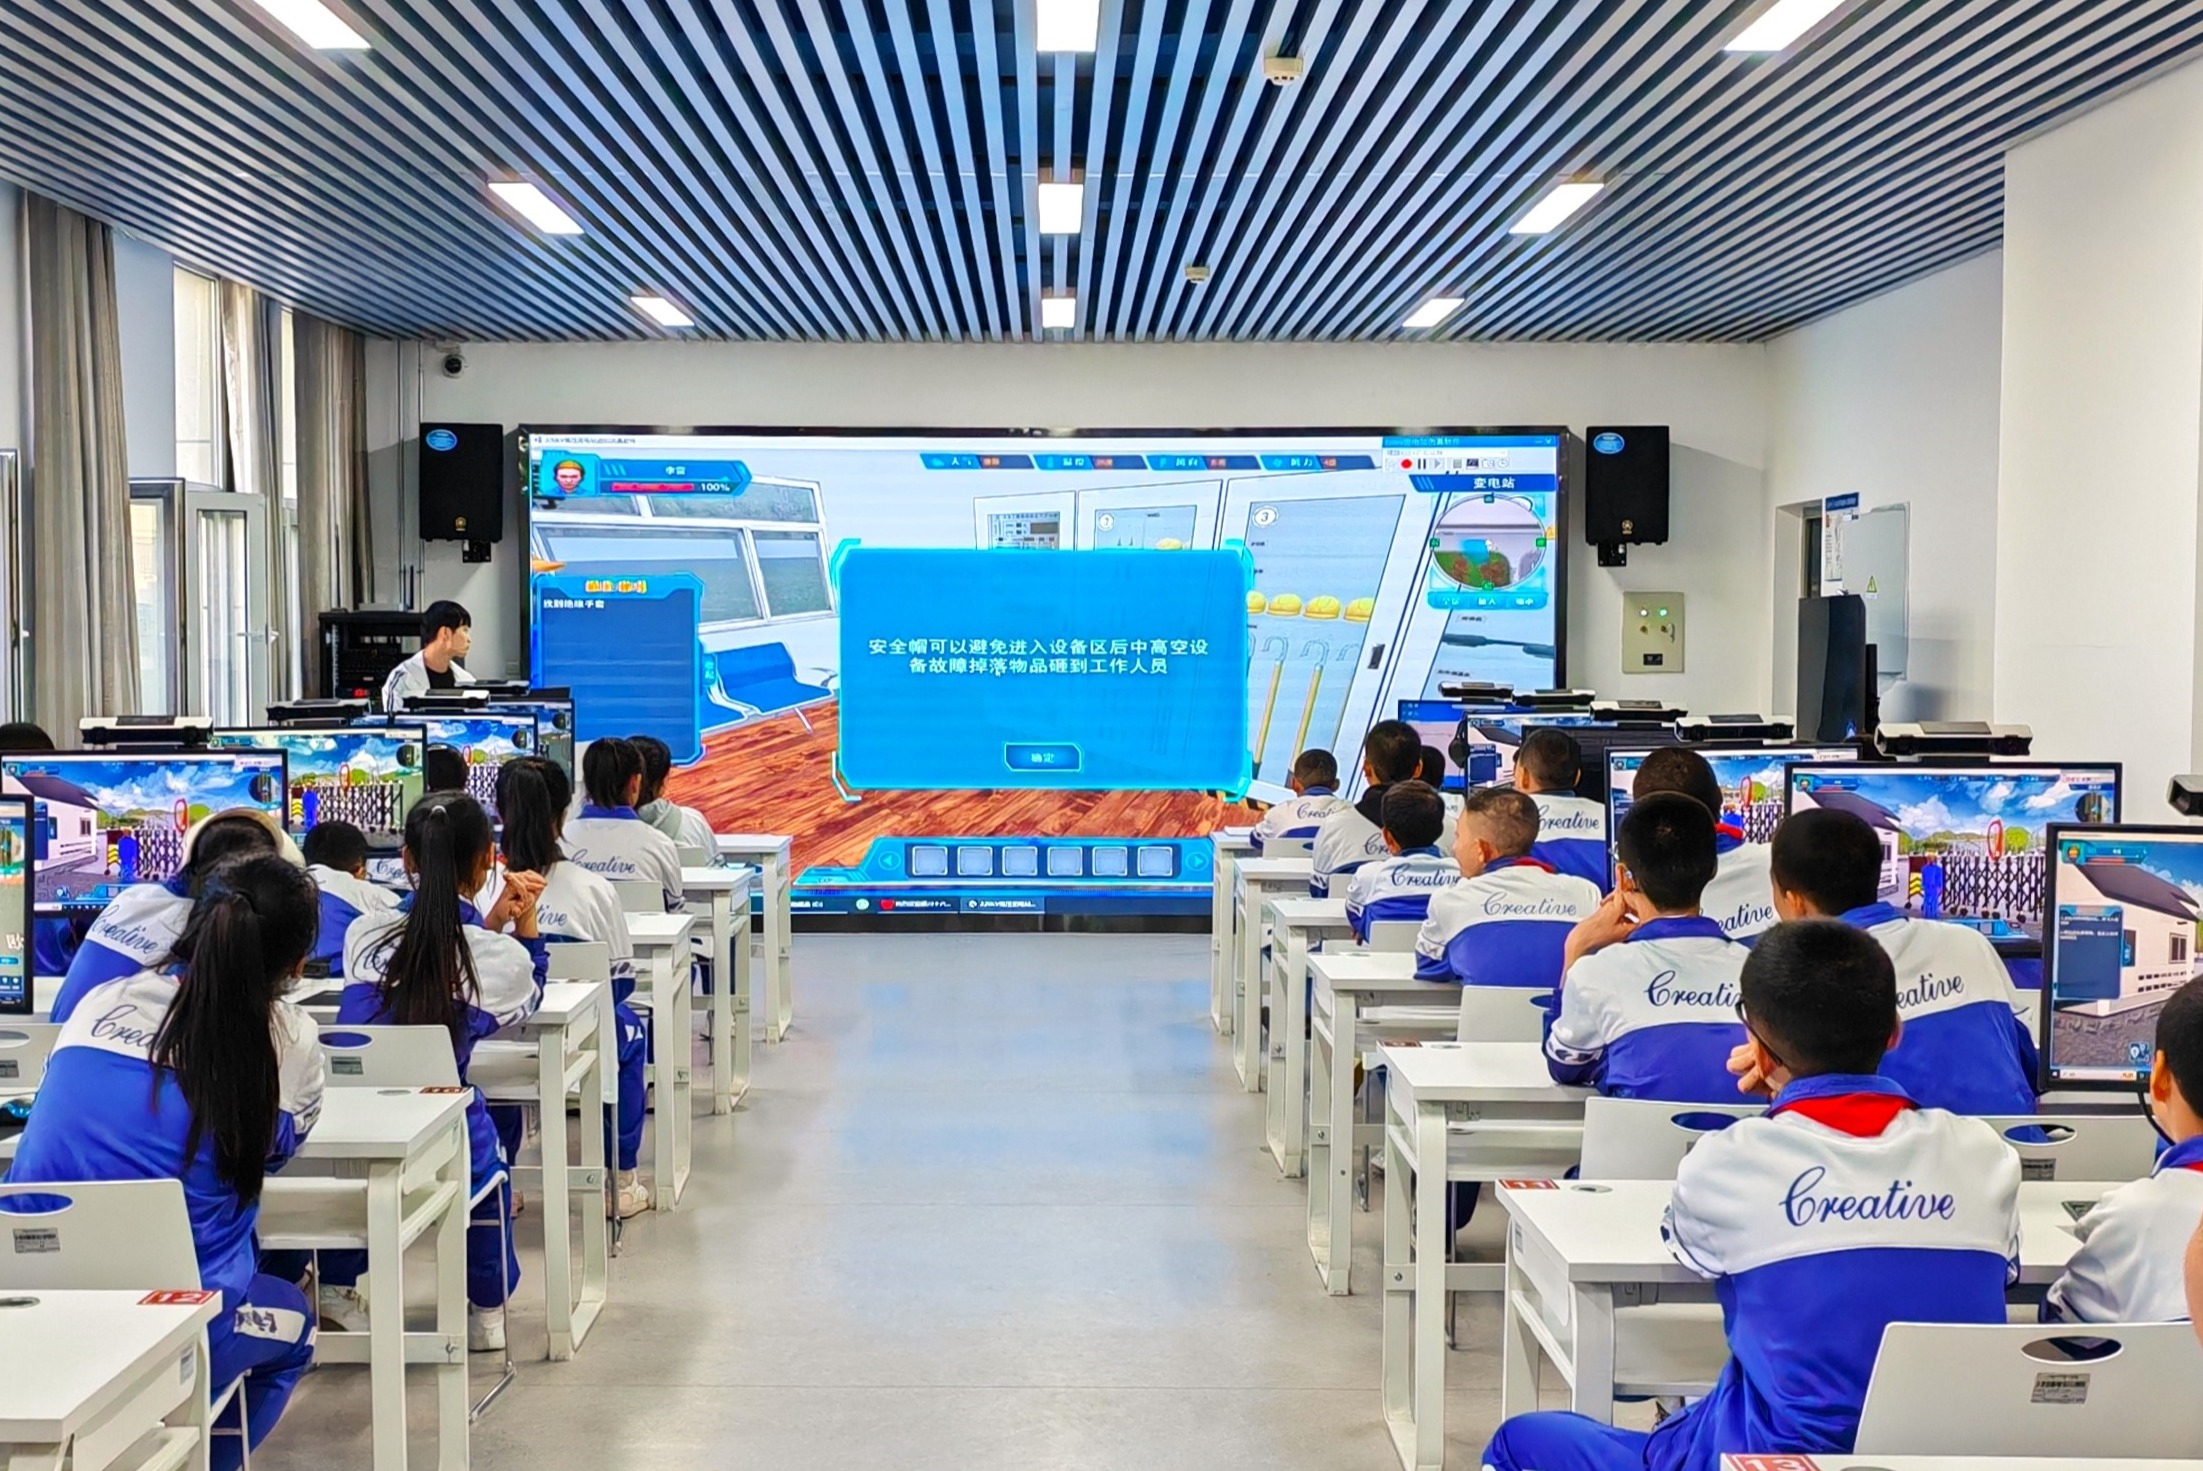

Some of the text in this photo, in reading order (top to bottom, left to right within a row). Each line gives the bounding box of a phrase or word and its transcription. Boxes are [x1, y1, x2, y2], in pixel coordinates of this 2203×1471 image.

[700, 482, 730, 492] 100%
[1473, 476, 1516, 489] 变电站
[1260, 511, 1269, 523] 3
[868, 638, 1209, 656] 安全帽可以避免进入设备区后中高空设
[909, 657, 1168, 675] 备故障掉落物品砸到工作人员
[1030, 752, 1056, 765] 确定
[1297, 802, 1338, 819] Creati
[1482, 891, 1577, 916] Creative
[536, 904, 568, 927] tive
[1718, 902, 1774, 933] eative
[91, 904, 158, 955] Creative
[1896, 973, 1965, 1010] eative
[1778, 1165, 1956, 1227] Creative
[157, 1292, 202, 1303] 12
